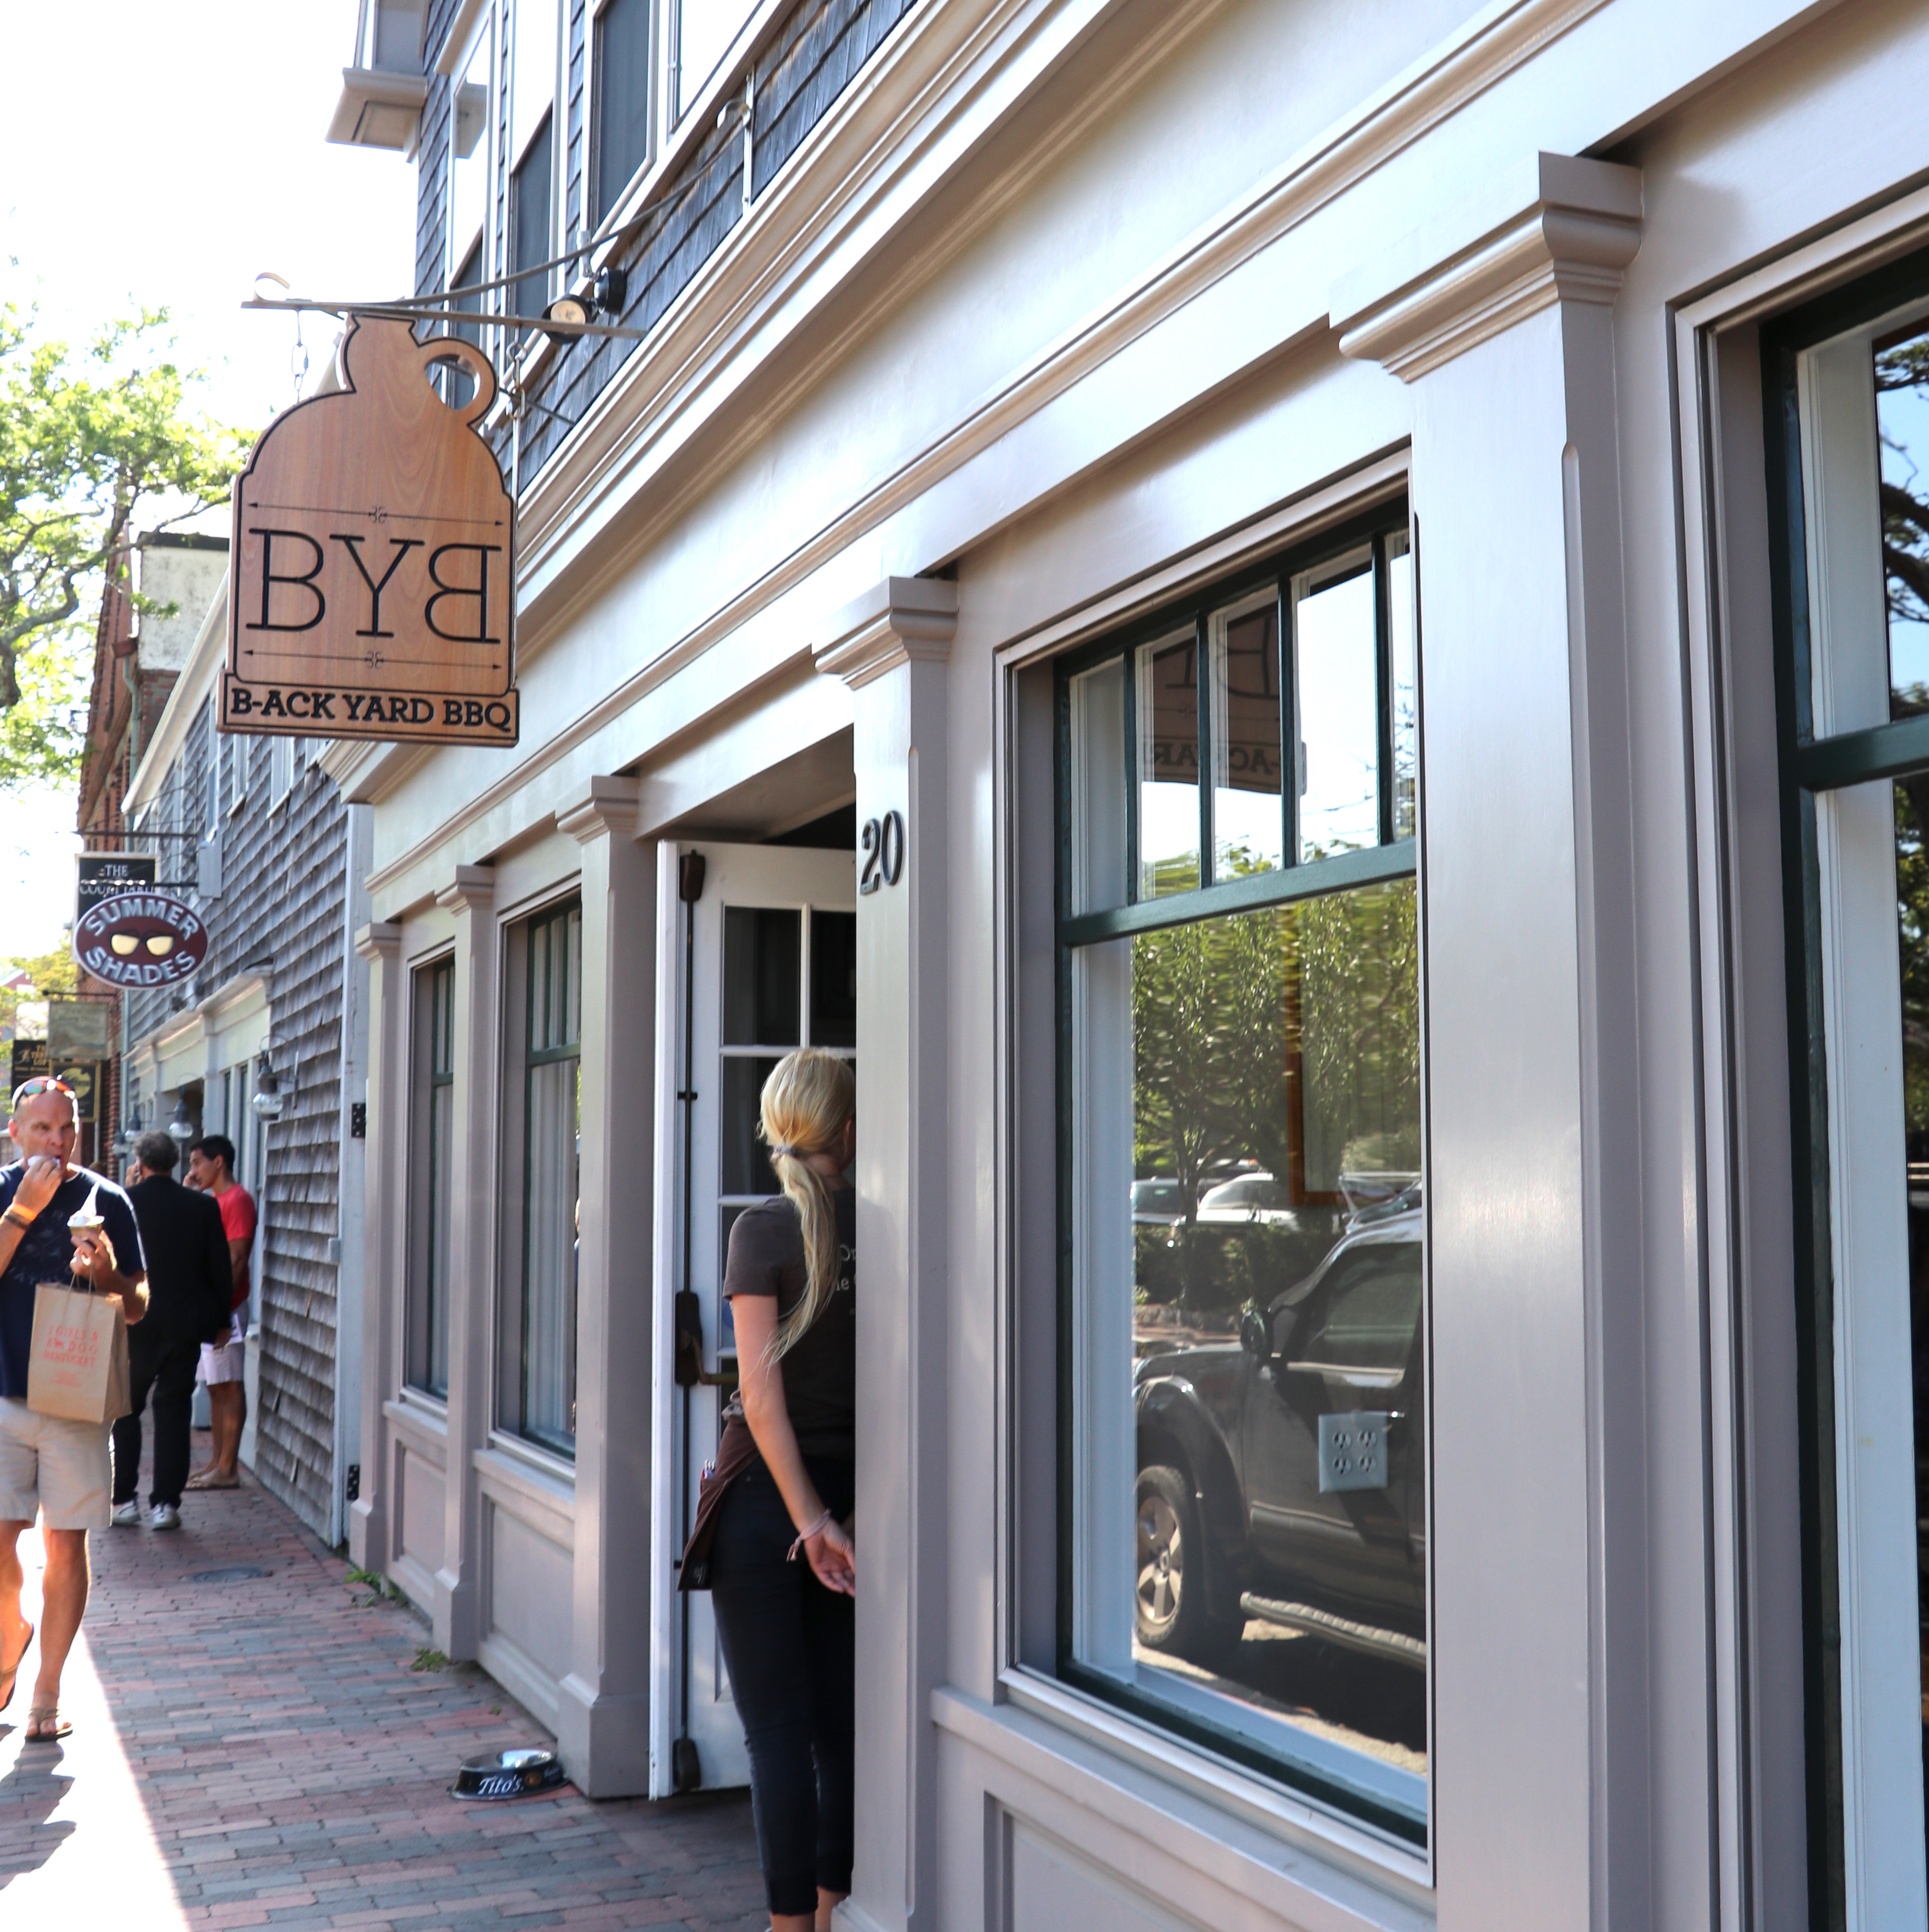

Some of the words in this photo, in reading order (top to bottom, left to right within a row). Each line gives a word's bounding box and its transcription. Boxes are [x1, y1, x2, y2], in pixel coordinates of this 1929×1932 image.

[342, 694, 434, 724] YARD
[442, 699, 512, 732] BBQ
[105, 864, 128, 877] THE
[859, 810, 903, 895] 20
[85, 897, 199, 941] SUMMER
[85, 946, 196, 985] SHADES
[477, 1774, 522, 1795] Tito's
